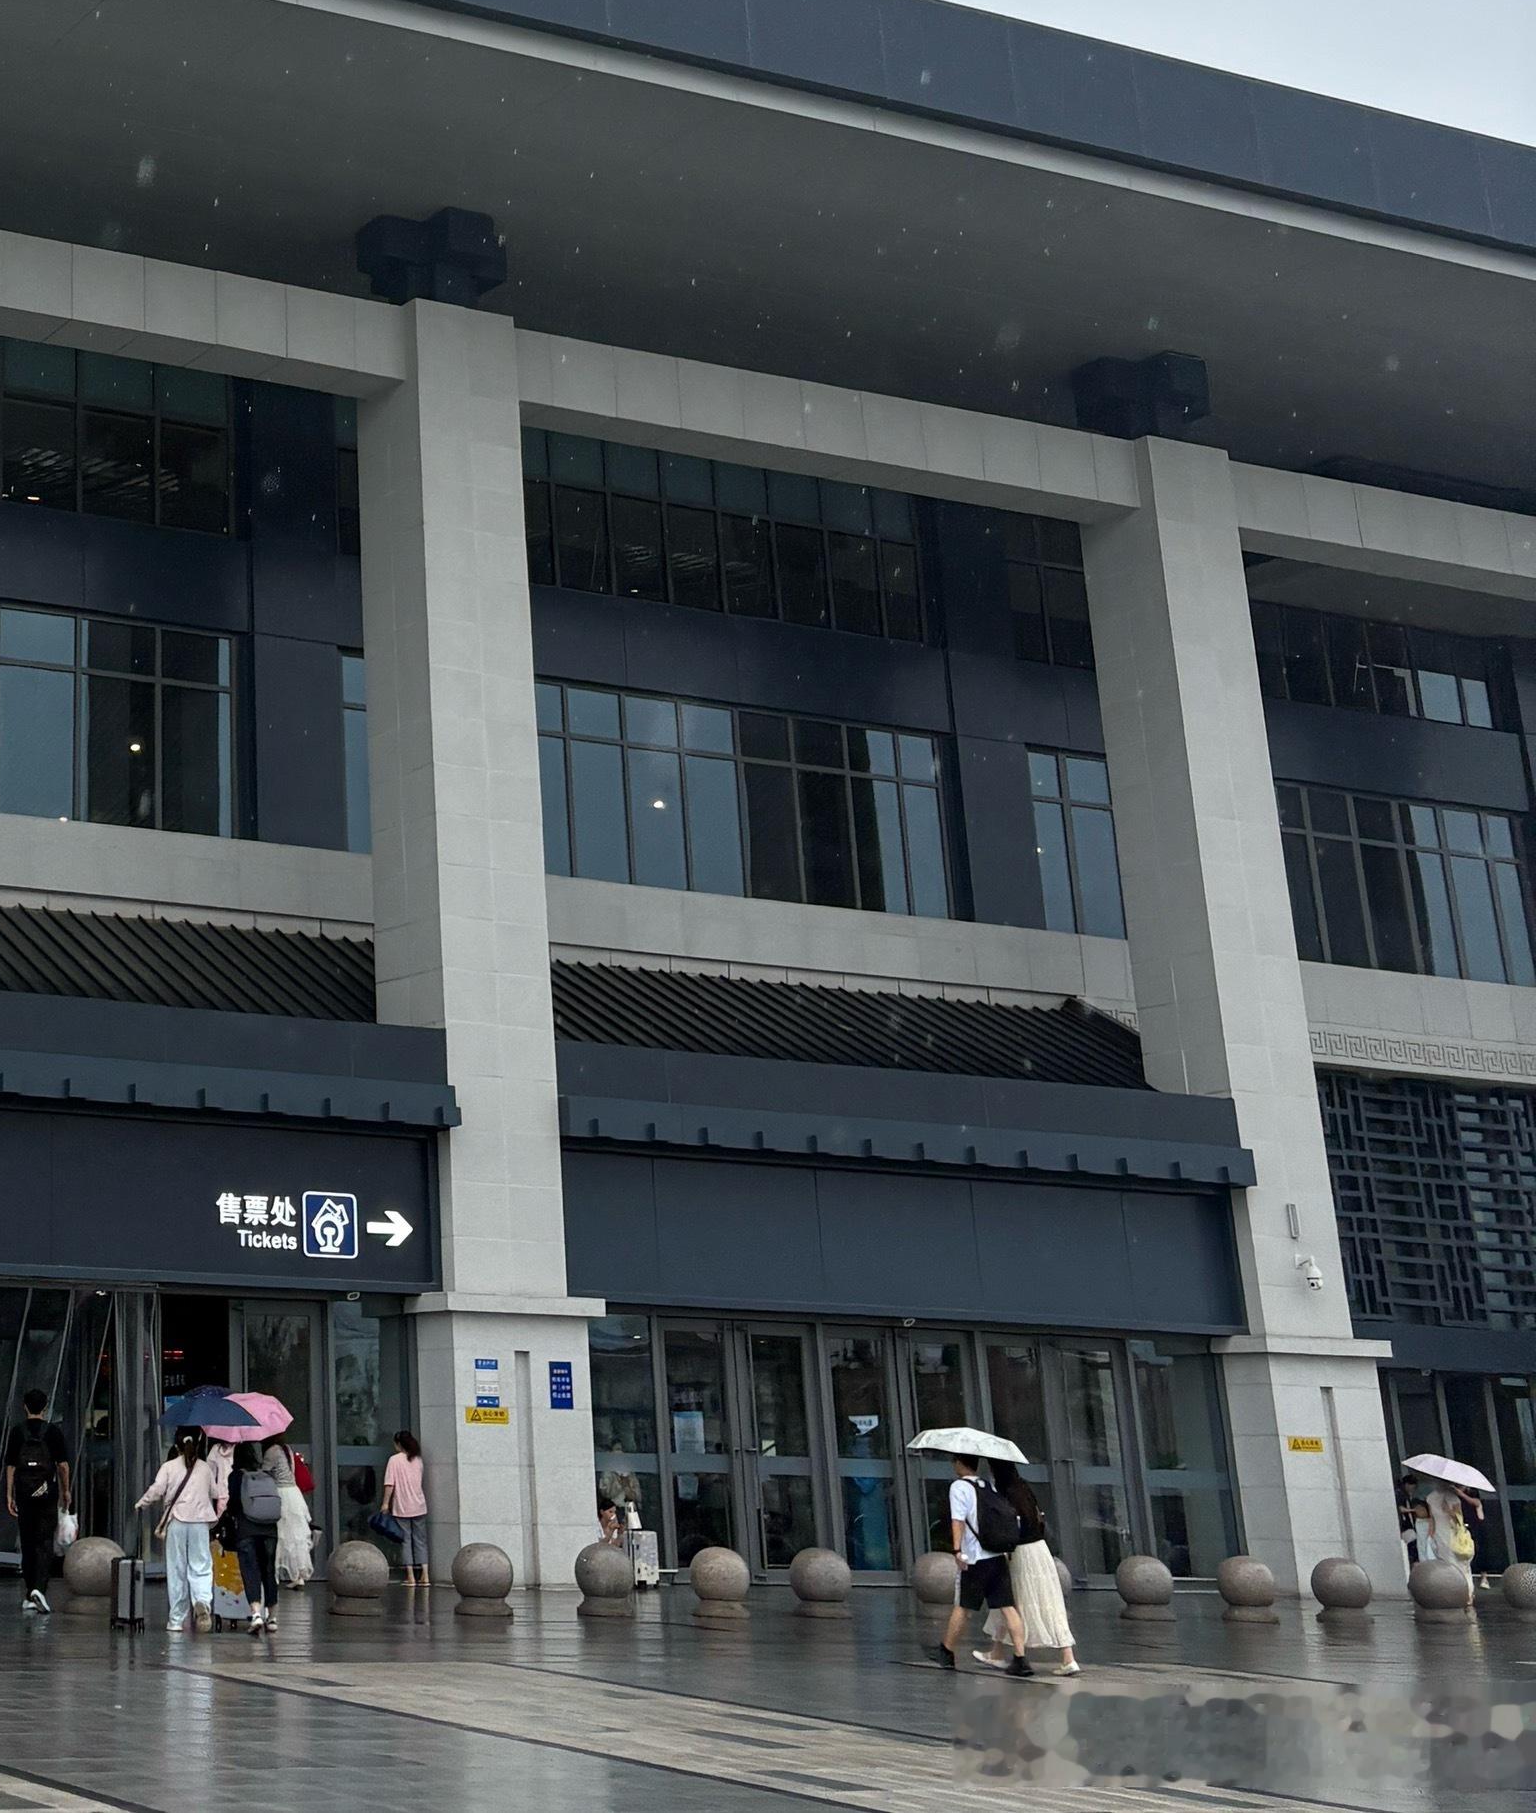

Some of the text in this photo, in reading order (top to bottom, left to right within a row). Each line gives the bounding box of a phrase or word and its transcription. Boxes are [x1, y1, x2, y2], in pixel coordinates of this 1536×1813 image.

[216, 1192, 297, 1227] 售票处
[237, 1230, 297, 1250] Tickets
